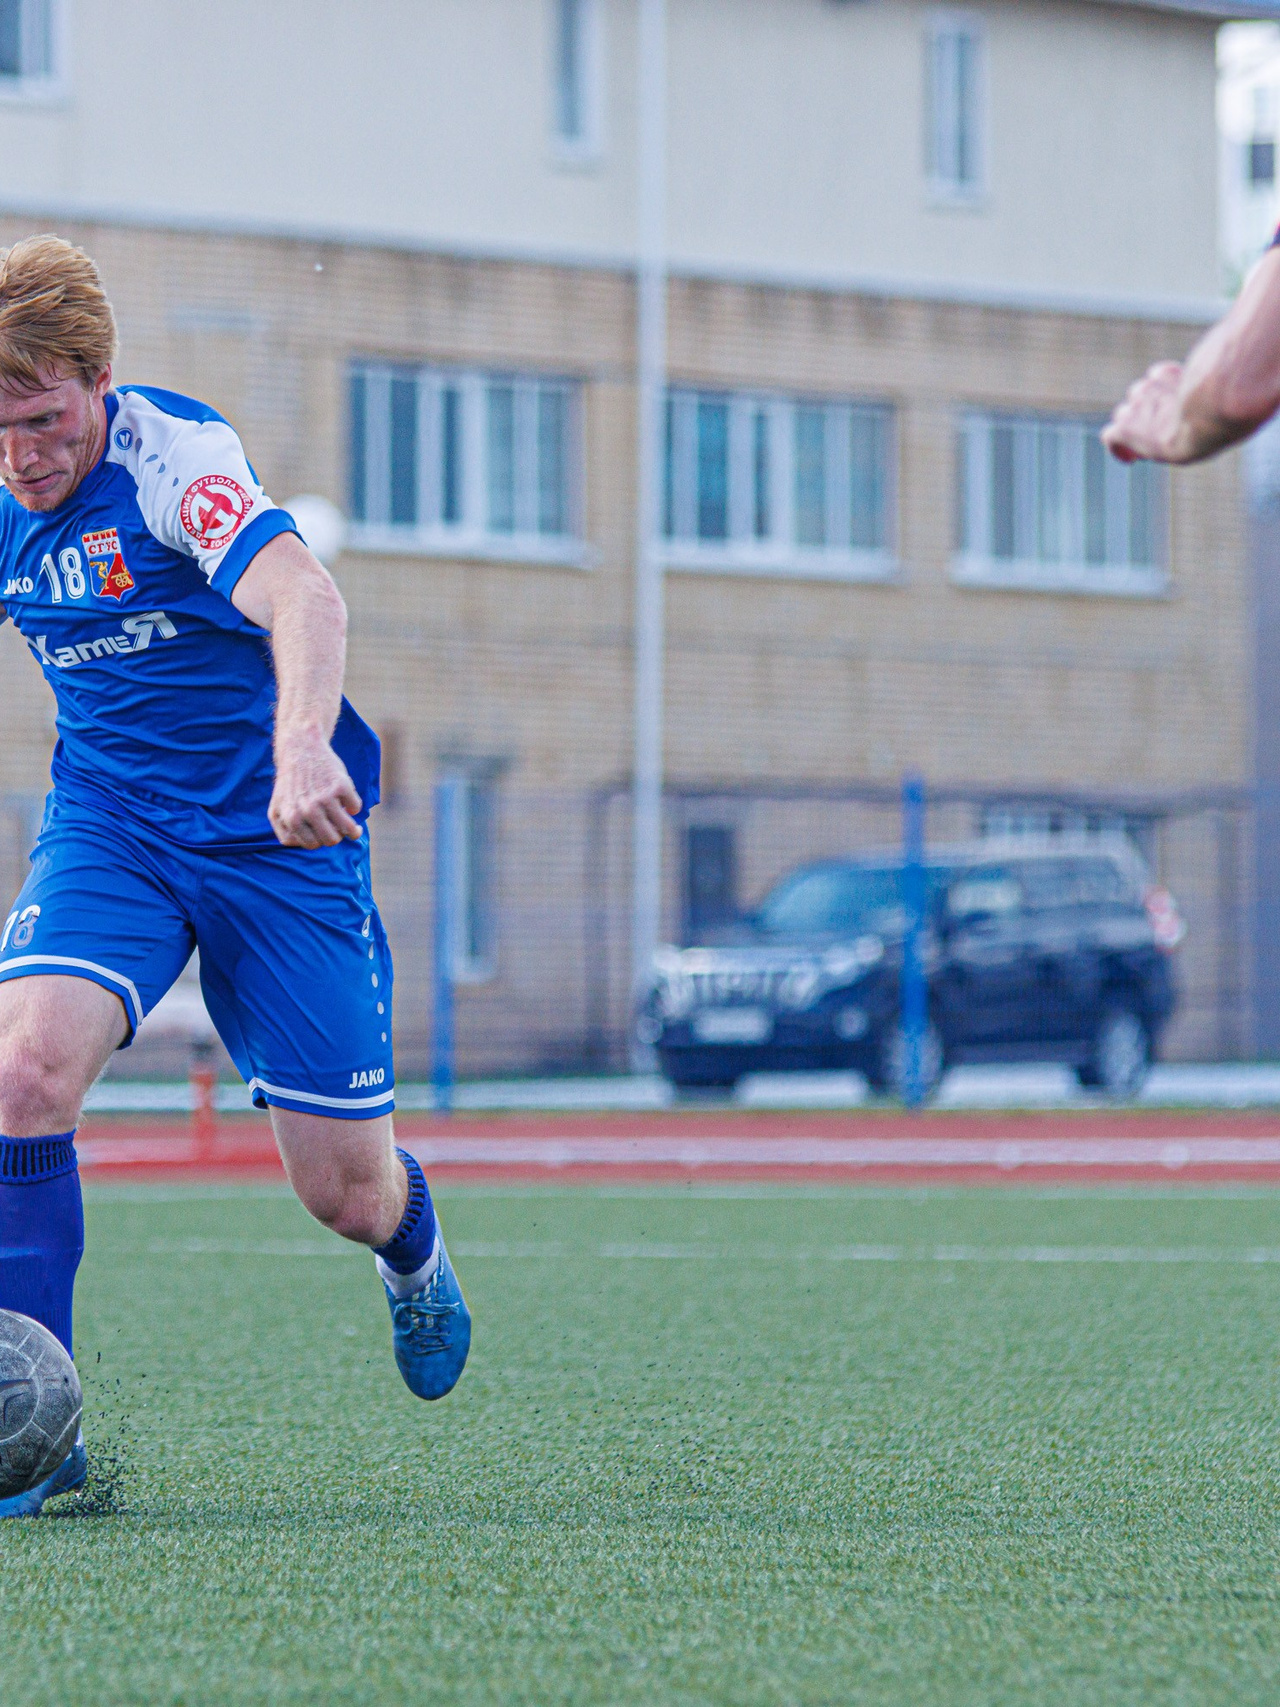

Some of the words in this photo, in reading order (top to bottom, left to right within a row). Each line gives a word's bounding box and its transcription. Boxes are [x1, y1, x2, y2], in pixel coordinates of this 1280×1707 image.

[190, 476, 237, 493] ФУТБОЛА
[39, 546, 86, 604] 18
[0, 904, 41, 952] 18
[348, 1067, 385, 1089] JAKO
